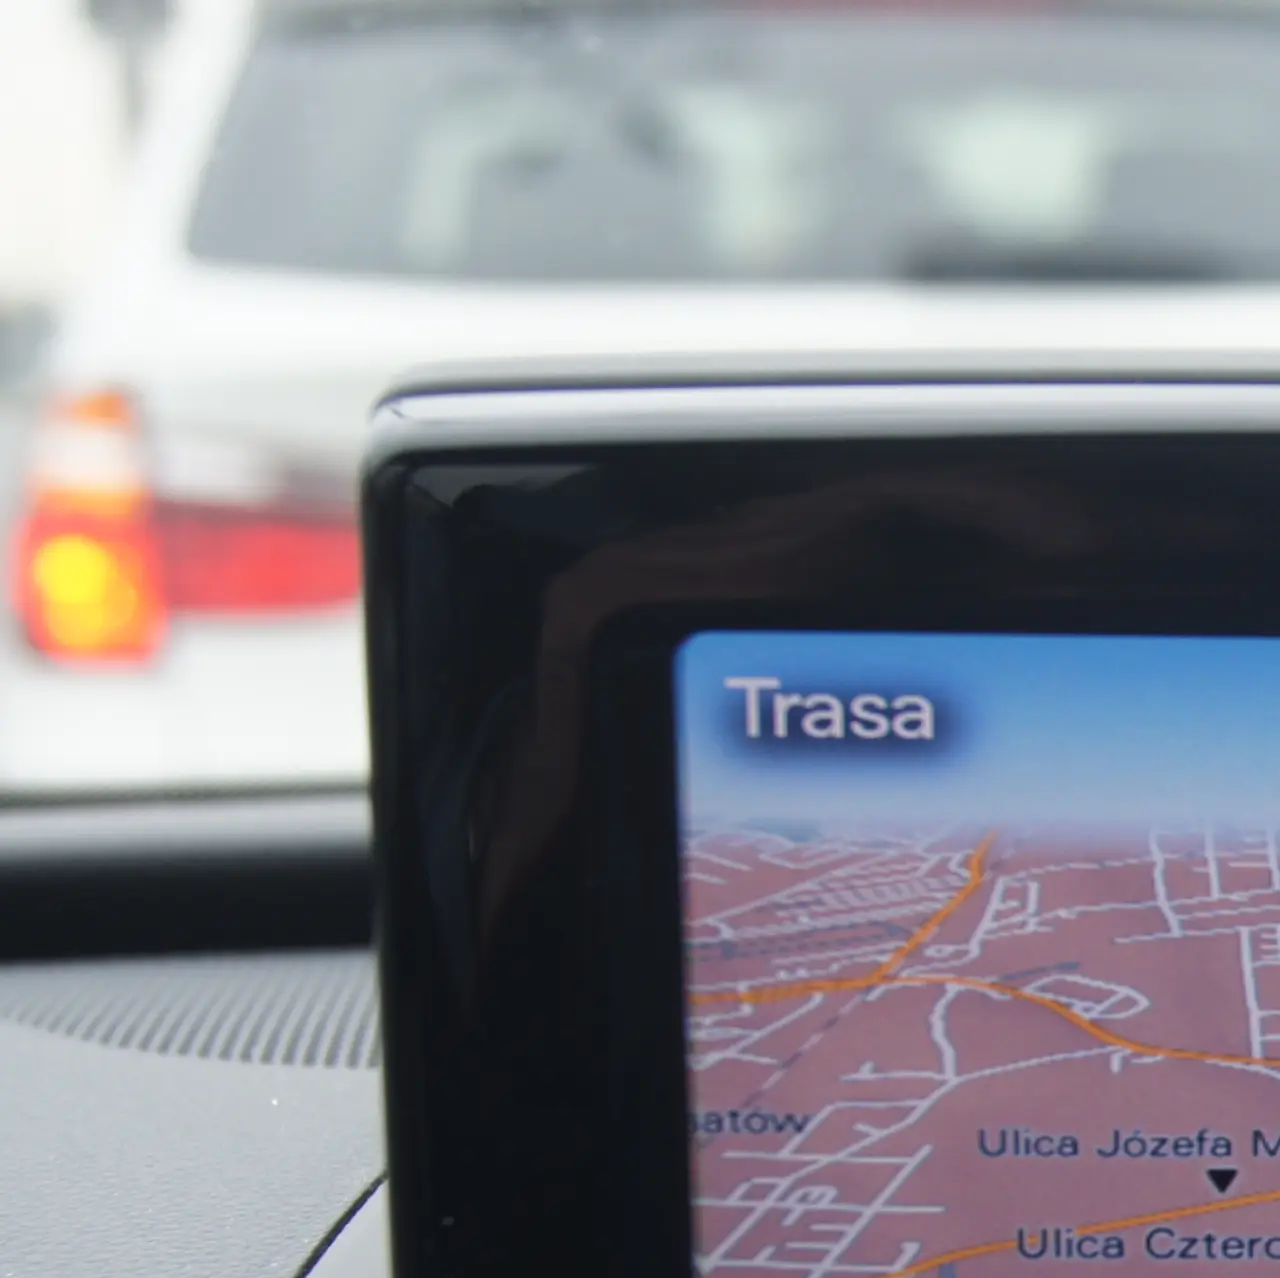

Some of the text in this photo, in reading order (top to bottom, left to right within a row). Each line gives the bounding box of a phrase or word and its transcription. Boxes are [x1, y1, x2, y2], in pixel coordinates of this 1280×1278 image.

[725, 676, 936, 740] Trasa
[978, 1129, 1079, 1158] Ulica
[1096, 1129, 1233, 1159] Józefa
[1016, 1228, 1125, 1260] Ulica
